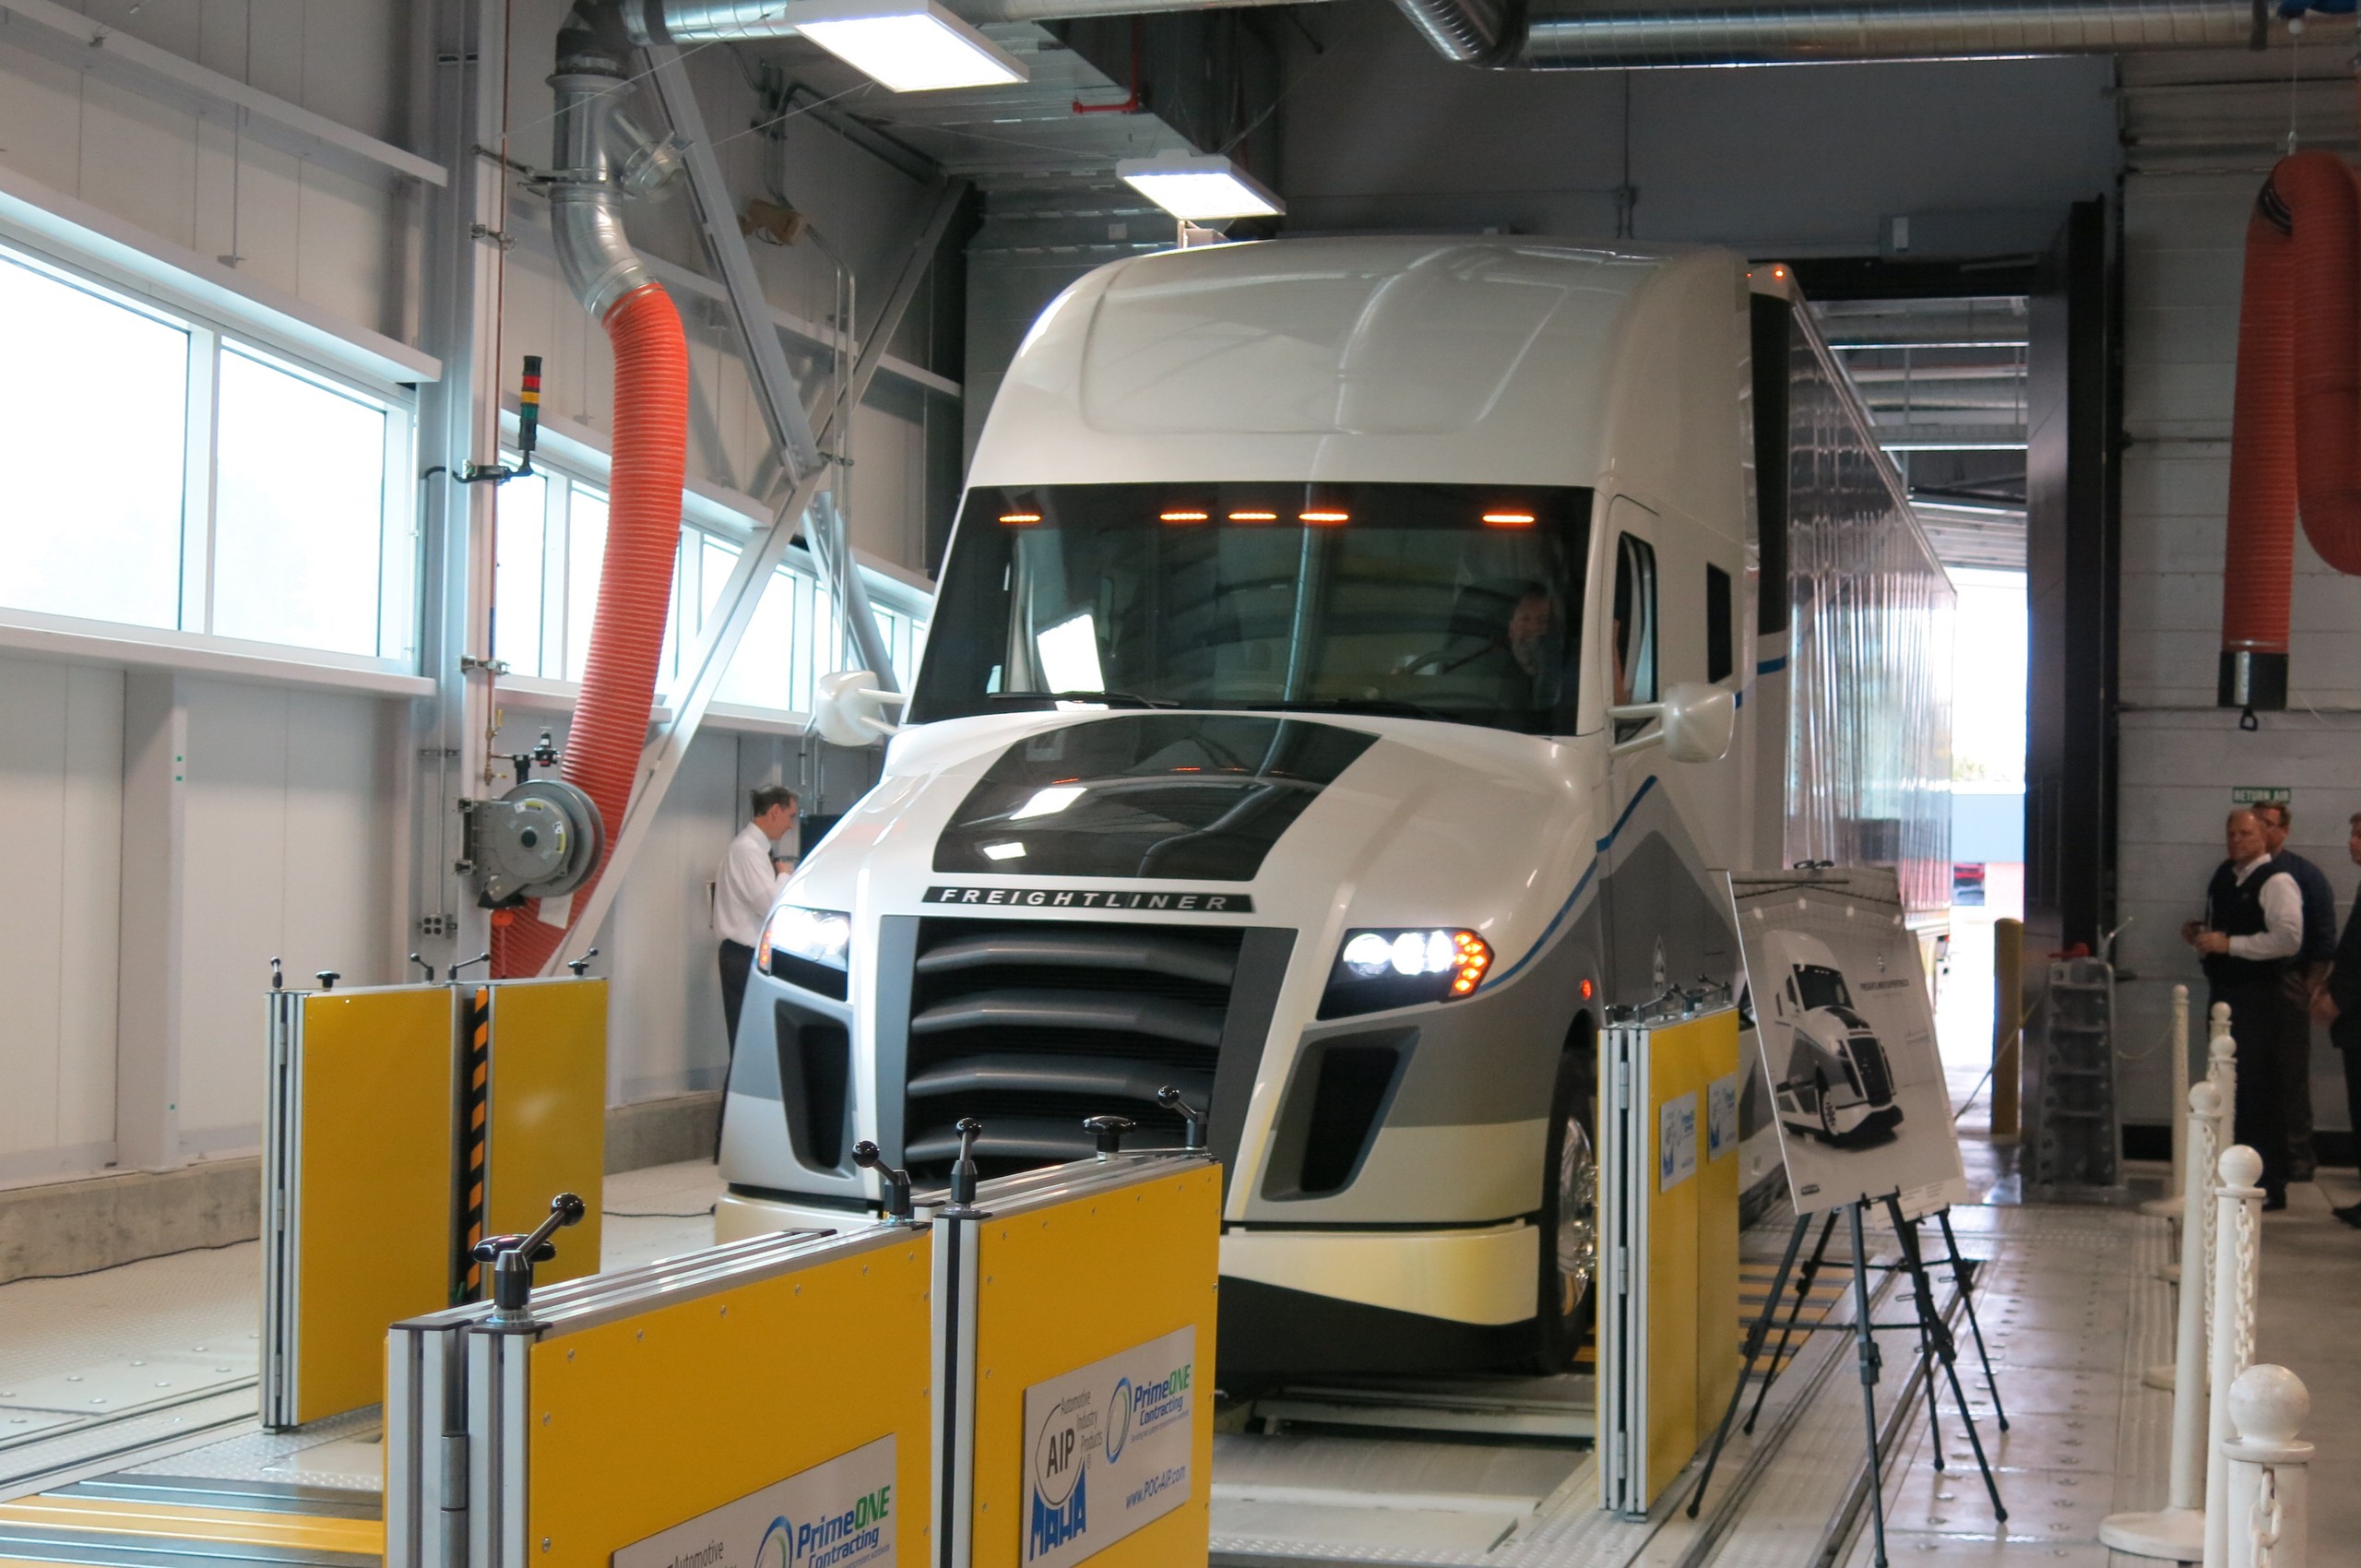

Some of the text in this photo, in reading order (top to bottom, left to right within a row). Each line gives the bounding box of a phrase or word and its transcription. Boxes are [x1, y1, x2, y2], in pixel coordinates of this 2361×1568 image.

[940, 888, 1228, 910] FREIGHTLINER
[1061, 1388, 1091, 1416] Automotive
[1133, 1364, 1191, 1413] PrimeONE
[1139, 1396, 1184, 1427] Contracting
[1046, 1428, 1075, 1479] AIP
[1125, 1466, 1186, 1510] www.POC-AIP.com
[796, 1485, 891, 1560] PrimeONE
[1029, 1462, 1086, 1562] MAHA
[673, 1539, 724, 1568] Automotive
[808, 1526, 880, 1568] Contracting
